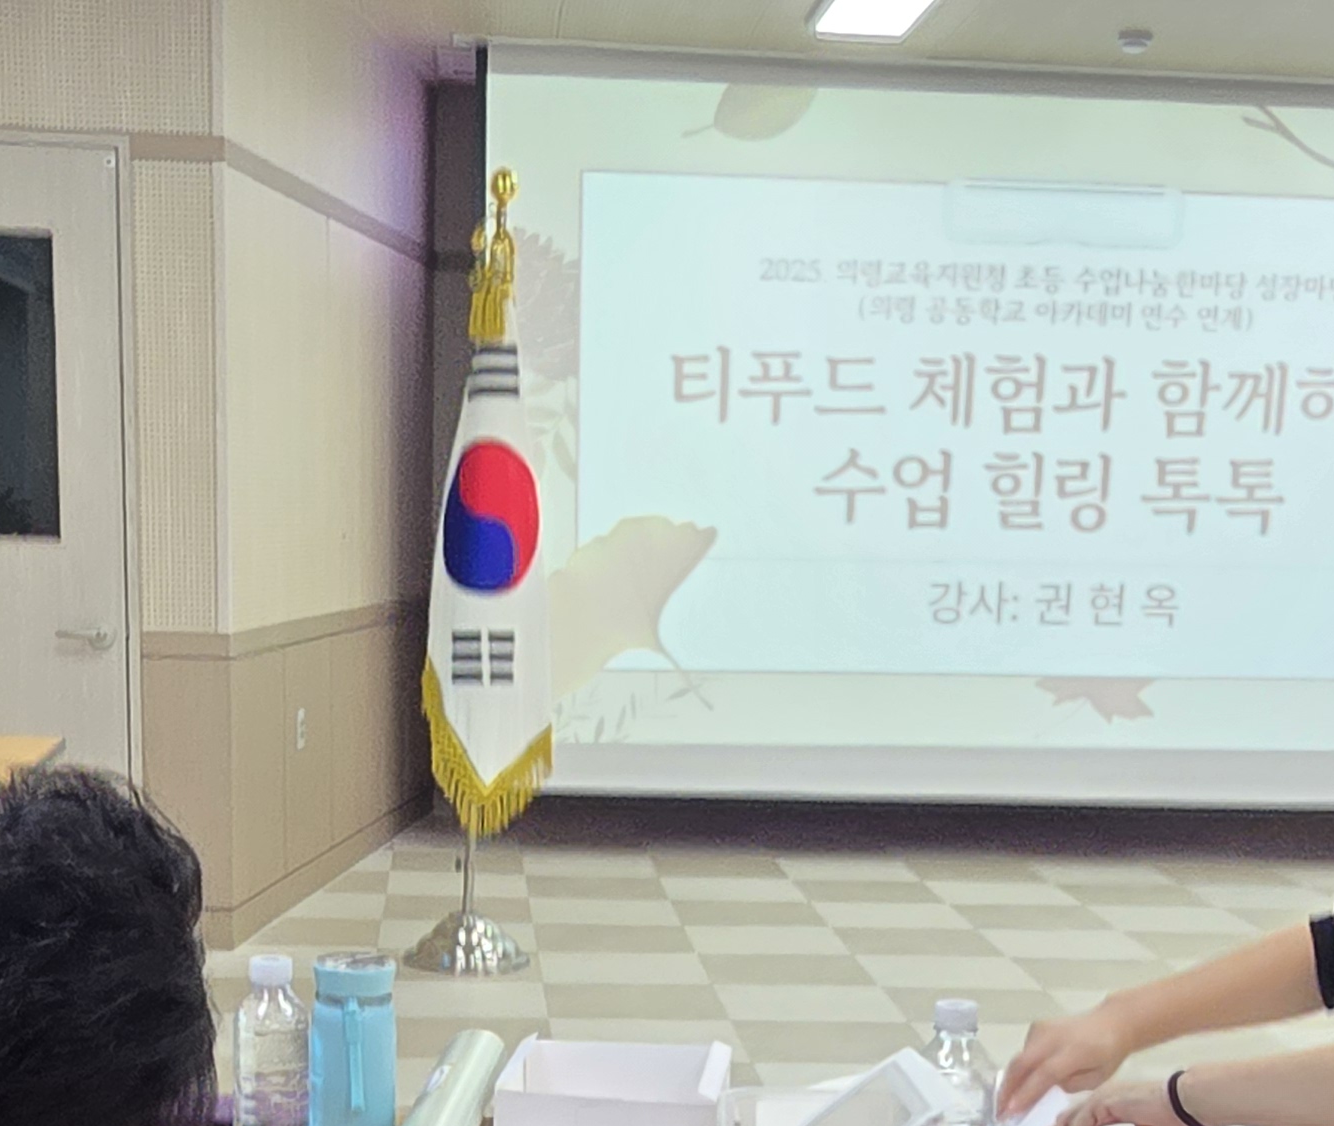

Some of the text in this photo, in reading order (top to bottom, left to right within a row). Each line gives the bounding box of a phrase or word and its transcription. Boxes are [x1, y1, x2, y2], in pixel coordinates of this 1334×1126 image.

[836, 259, 1006, 292] 의령교육지원청
[1014, 264, 1065, 295] 초등
[858, 294, 1254, 332] (의령 공동학교 아카데미 연수 연계)
[670, 344, 887, 426] 티푸드
[909, 352, 1127, 435] 체험과
[813, 448, 1285, 537] 수업 힐링 톡톡
[928, 580, 1020, 626] 강사:
